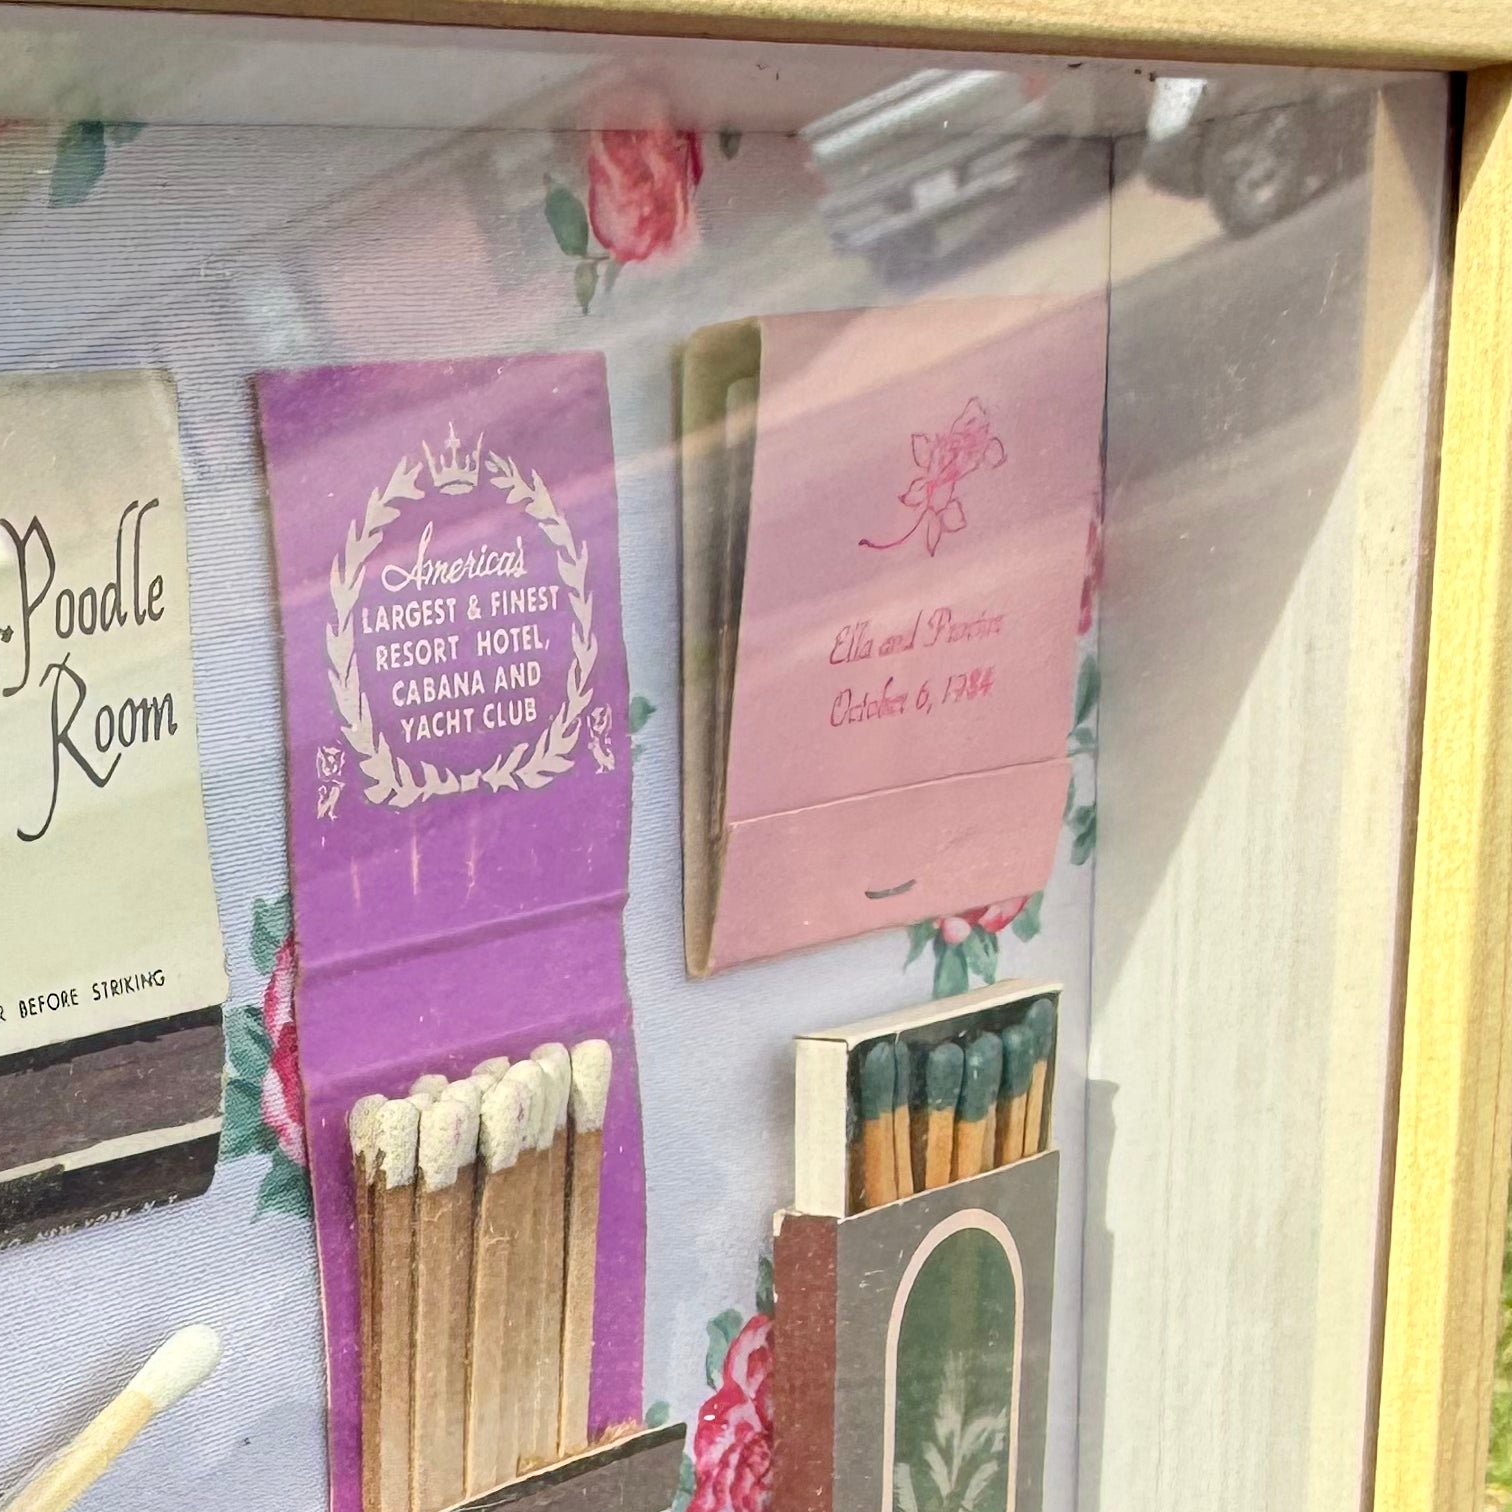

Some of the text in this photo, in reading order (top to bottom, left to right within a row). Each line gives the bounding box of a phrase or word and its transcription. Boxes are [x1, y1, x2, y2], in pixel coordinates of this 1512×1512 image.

[361, 585, 560, 634] LARGEST & FINEST
[375, 625, 551, 671] RESORT HOTEL,
[392, 661, 542, 707] CABANA AND
[400, 697, 538, 744] YACHT CLUB
[17, 651, 177, 841] Room
[18, 988, 78, 1018] BEFORE
[92, 969, 166, 1003] STRIKING
